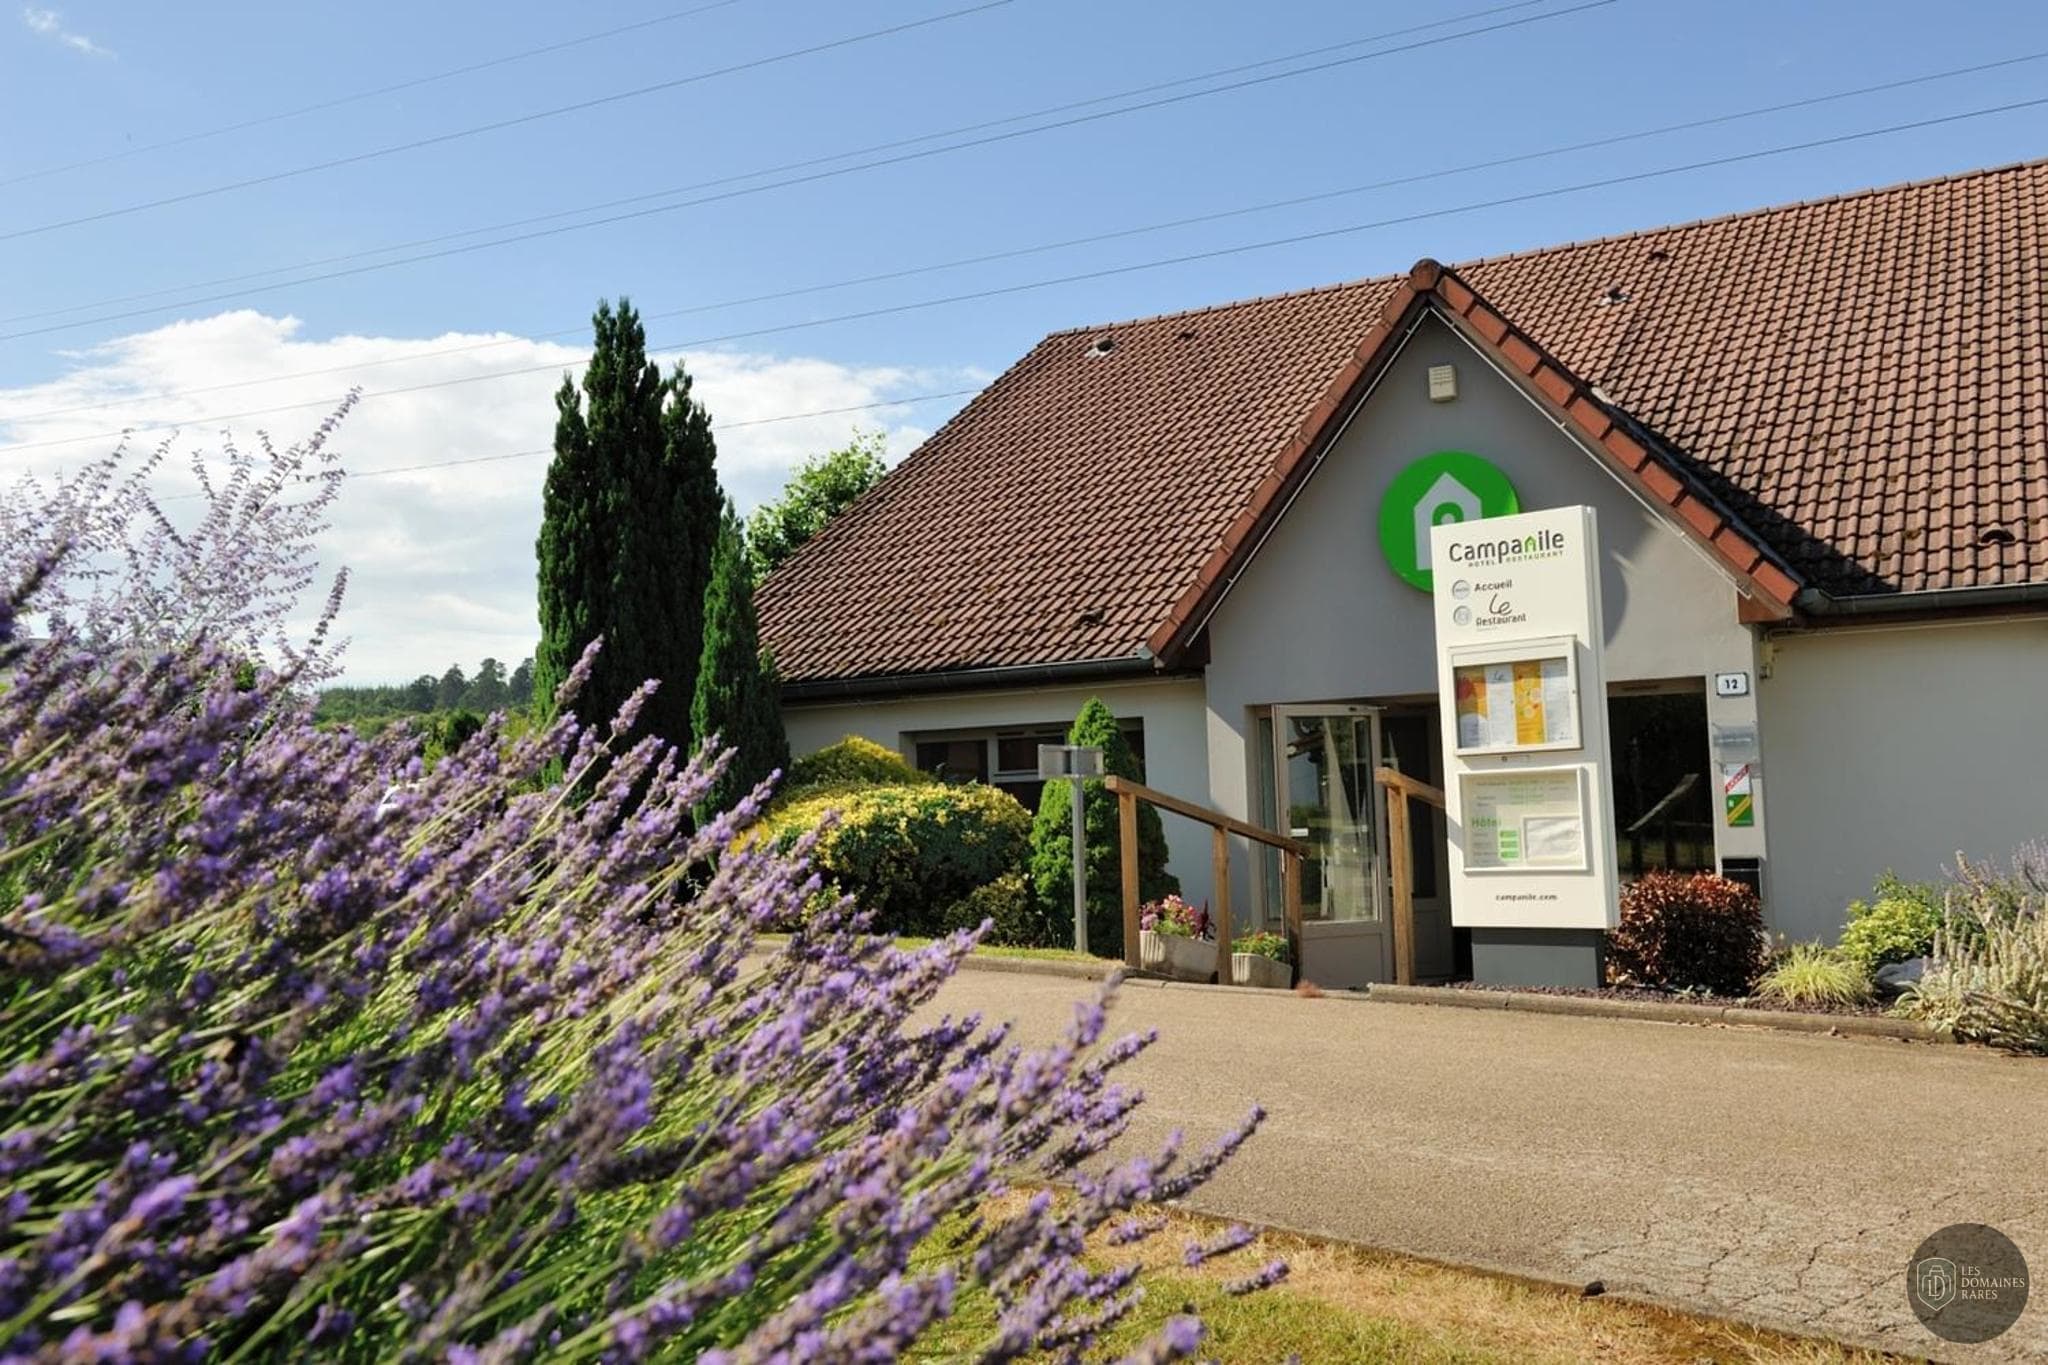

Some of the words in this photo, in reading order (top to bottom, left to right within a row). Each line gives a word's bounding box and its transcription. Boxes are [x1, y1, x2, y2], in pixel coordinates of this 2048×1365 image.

[1449, 529, 1565, 563] Campanile
[1506, 550, 1565, 563] RESTAURANT
[1474, 579, 1513, 592] Accueil
[1489, 593, 1513, 616] Le
[1475, 613, 1527, 626] Restaurant
[1724, 679, 1738, 689] 12
[1496, 893, 1558, 902] campanile.com
